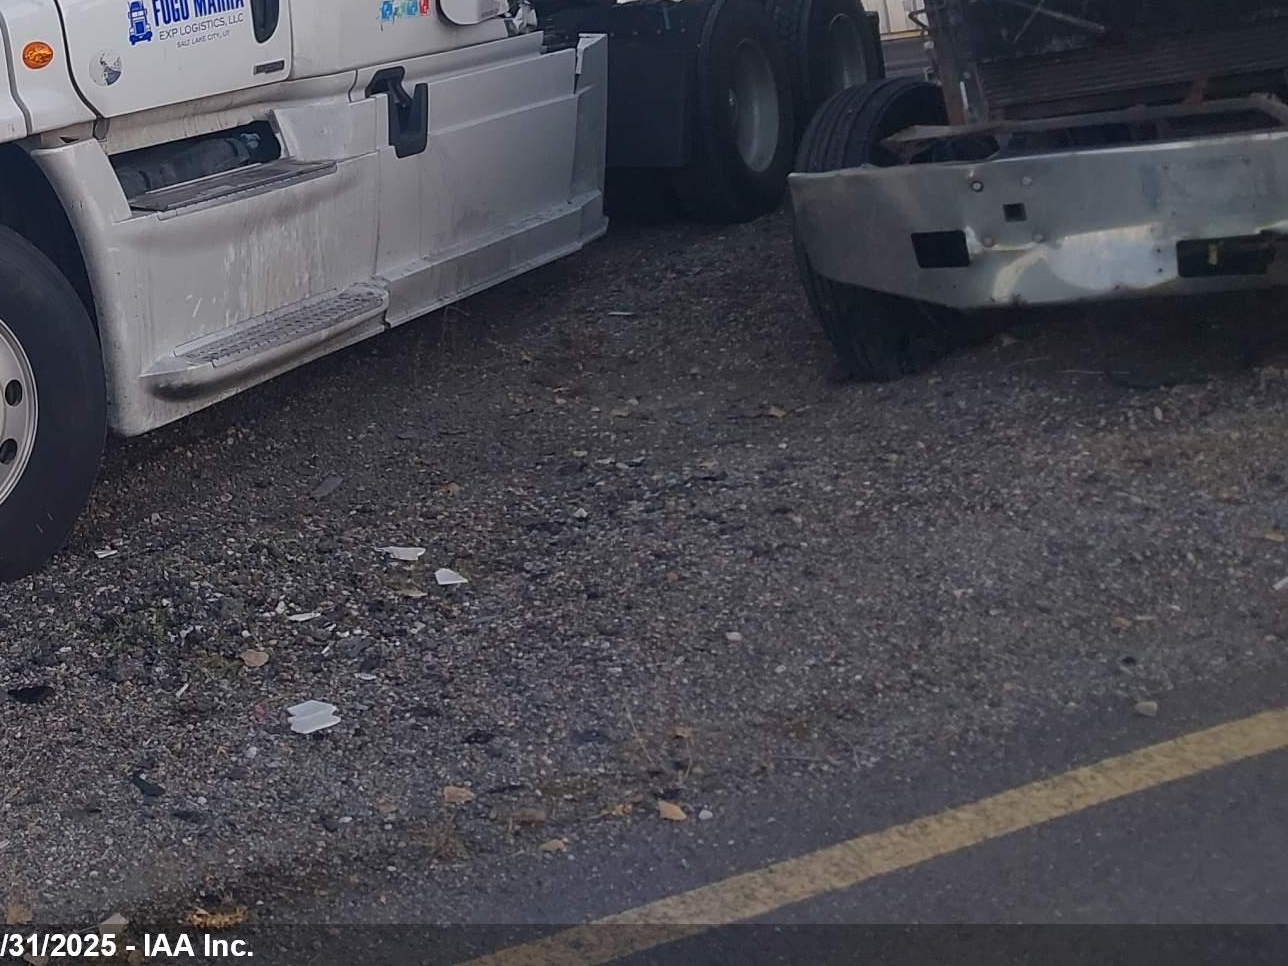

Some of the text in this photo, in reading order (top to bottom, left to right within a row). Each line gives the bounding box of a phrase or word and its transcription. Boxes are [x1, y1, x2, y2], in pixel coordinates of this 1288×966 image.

[159, 13, 244, 41] EXP LOGISTICS, LLC
[177, 39, 190, 48] SALT
[191, 35, 207, 45] LAKE
